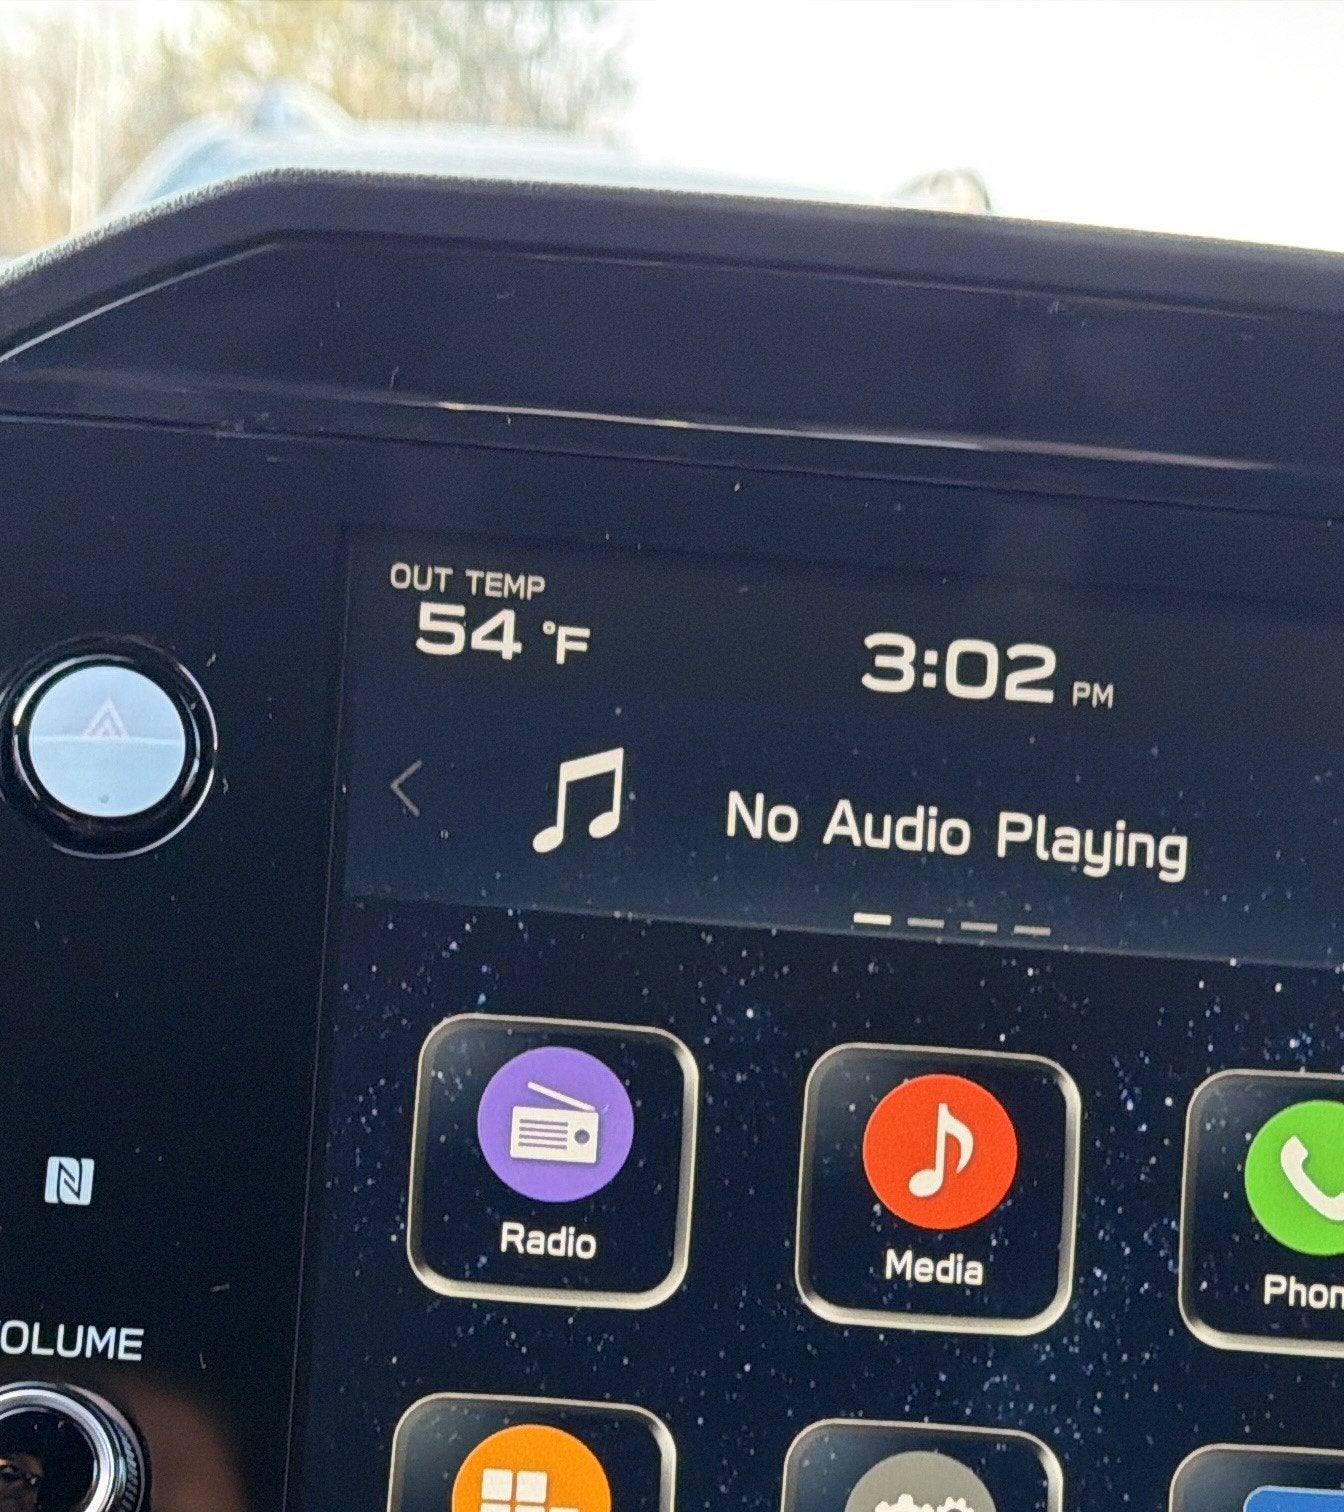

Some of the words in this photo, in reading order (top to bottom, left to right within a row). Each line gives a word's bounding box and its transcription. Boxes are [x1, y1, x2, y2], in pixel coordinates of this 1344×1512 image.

[390, 562, 454, 593] OUT
[465, 569, 546, 601] TEMP
[415, 601, 523, 661] 54
[861, 632, 1057, 704] 3:02
[1072, 680, 1114, 709] PM
[726, 790, 799, 843] No
[822, 799, 971, 856] Audio
[997, 811, 1188, 883] Playing
[500, 1221, 597, 1260] Radio
[885, 1248, 984, 1286] Media
